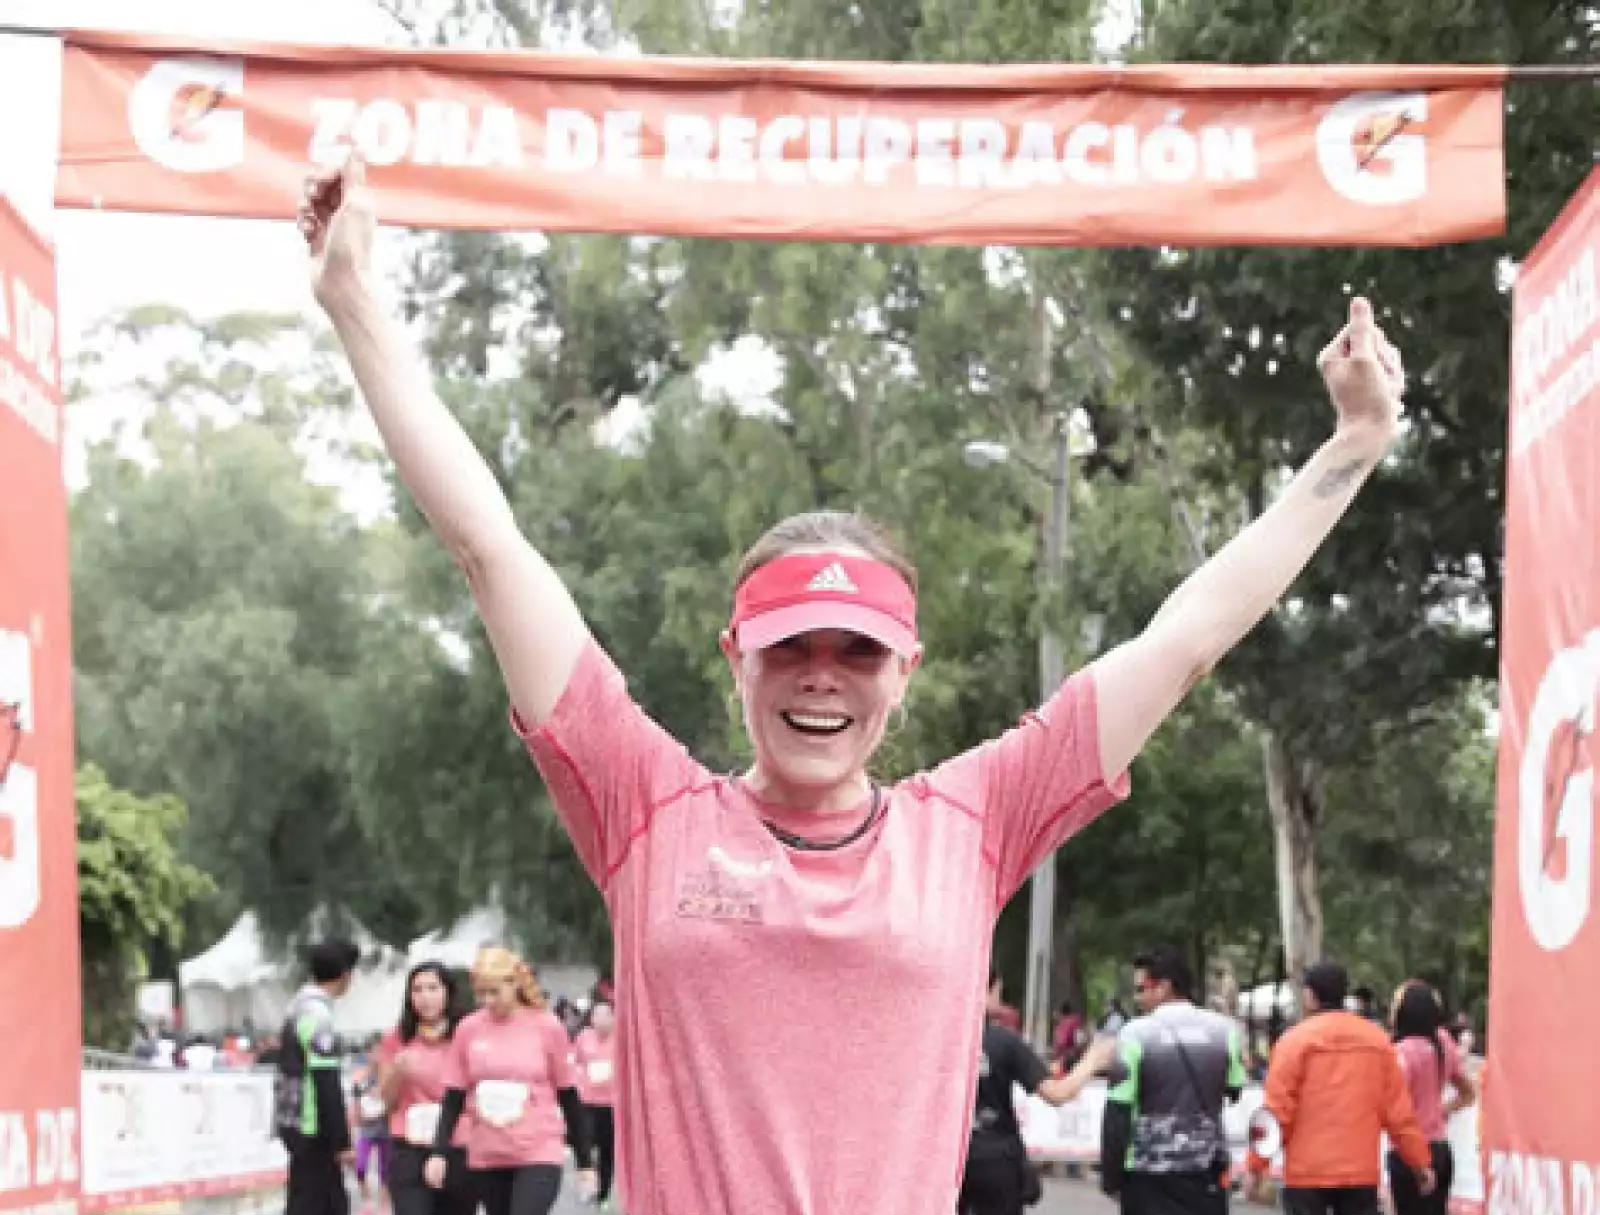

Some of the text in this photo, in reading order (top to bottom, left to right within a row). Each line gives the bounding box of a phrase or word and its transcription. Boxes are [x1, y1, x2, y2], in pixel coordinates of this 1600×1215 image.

[308, 98, 1257, 188] ZONA DE RECUPERACIÓN
[1316, 90, 1428, 205] G
